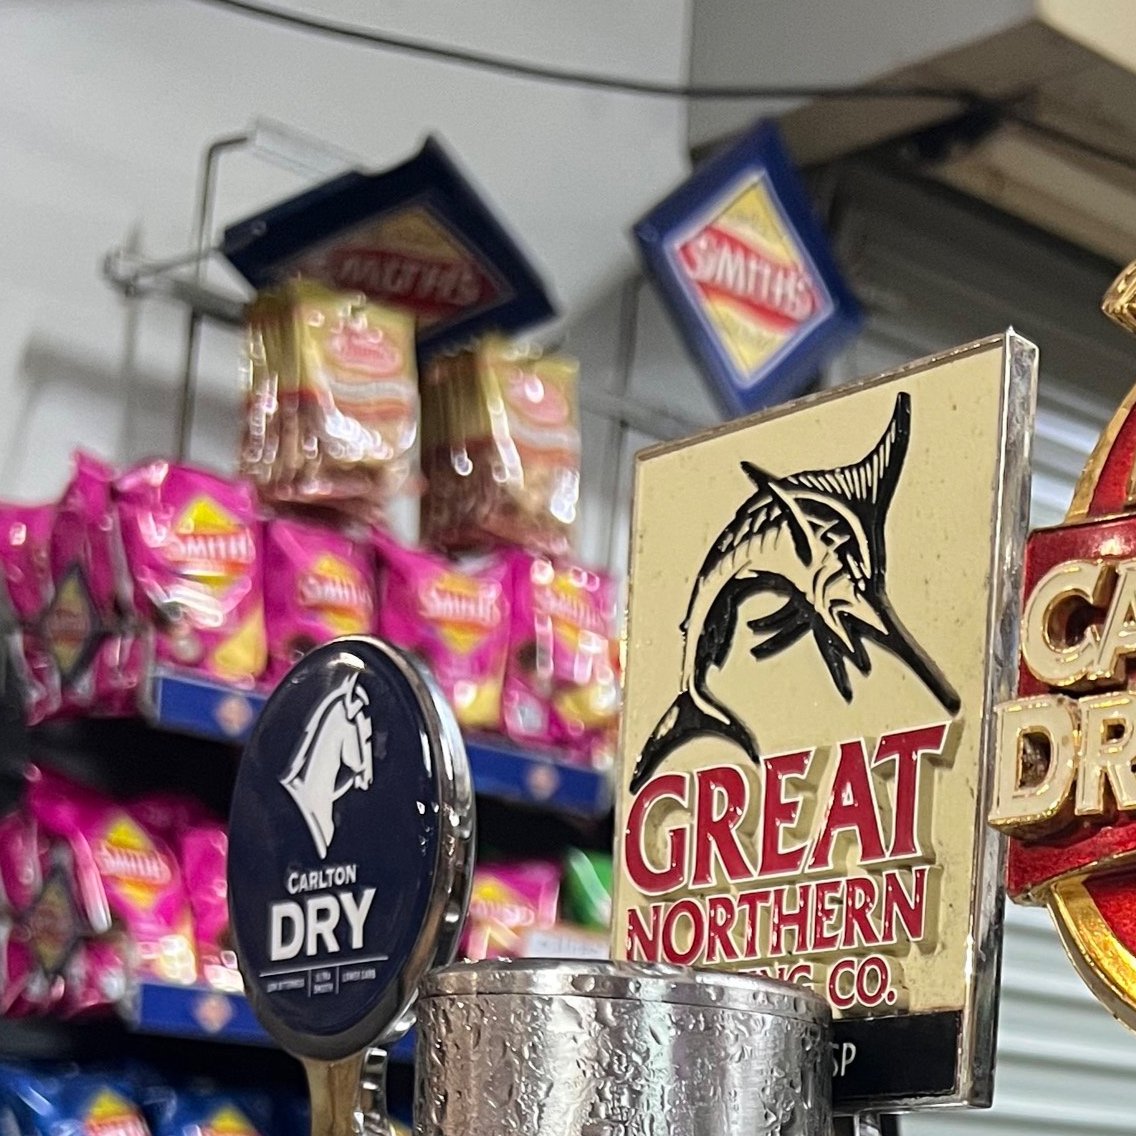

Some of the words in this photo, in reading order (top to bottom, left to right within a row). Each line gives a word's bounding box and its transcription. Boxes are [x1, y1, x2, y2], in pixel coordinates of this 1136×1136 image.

[624, 720, 951, 896] GREAT
[286, 864, 358, 895] CARLTON
[625, 866, 929, 966] NORTHERN
[270, 887, 378, 962] DRY
[827, 953, 898, 1010] CO.
